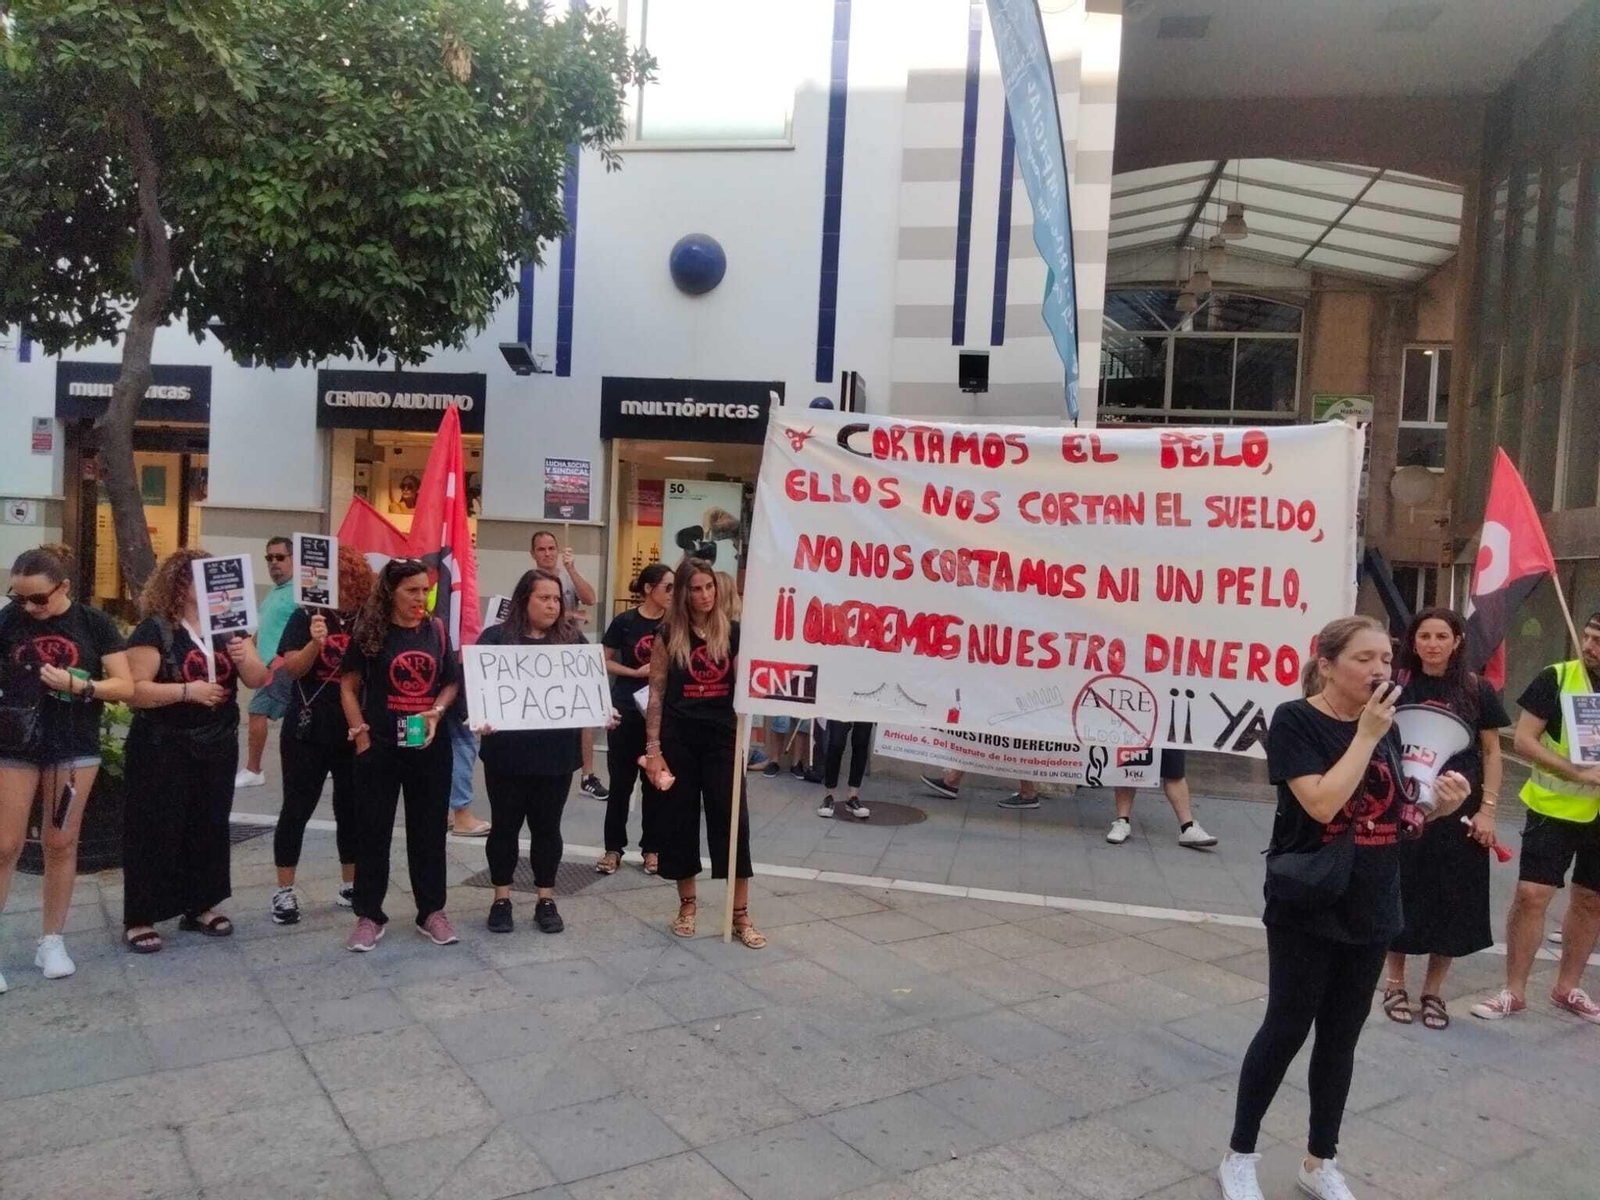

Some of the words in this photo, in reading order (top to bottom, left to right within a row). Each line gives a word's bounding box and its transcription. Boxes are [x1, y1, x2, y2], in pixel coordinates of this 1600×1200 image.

[325, 390, 391, 408] CENTRO
[392, 393, 473, 411] AUDITIVO
[836, 423, 1029, 468] CORTAMOS
[1062, 432, 1119, 463] EL
[1160, 430, 1273, 475] PELO,
[545, 460, 566, 468] LUCHA
[567, 461, 589, 469] SOCIAL
[552, 468, 589, 476] SINDICAL
[785, 469, 901, 509] ELLOS
[922, 482, 1001, 523] NOS
[1018, 491, 1145, 527] CORTAN
[1156, 492, 1191, 526] EL
[1205, 496, 1324, 542] SUELDO,
[794, 534, 843, 572] NO
[849, 541, 914, 580] NOS
[921, 548, 1086, 599] CORTAMOS
[1097, 564, 1139, 602] NI
[1156, 564, 1203, 603] UN
[1217, 566, 1308, 615] PELO,
[967, 623, 1126, 676] NUESTRO
[480, 650, 605, 680] PAKO-RÓN
[750, 667, 814, 698] CNT
[480, 684, 606, 720] ¡PAGA!
[1081, 687, 1152, 712] AIRE
[933, 738, 947, 749] Del
[950, 742, 985, 758] Estatuto
[988, 751, 1000, 761] de
[1003, 754, 1017, 764] los
[1020, 757, 1083, 768] trabajadores
[1120, 750, 1149, 762] CNT
